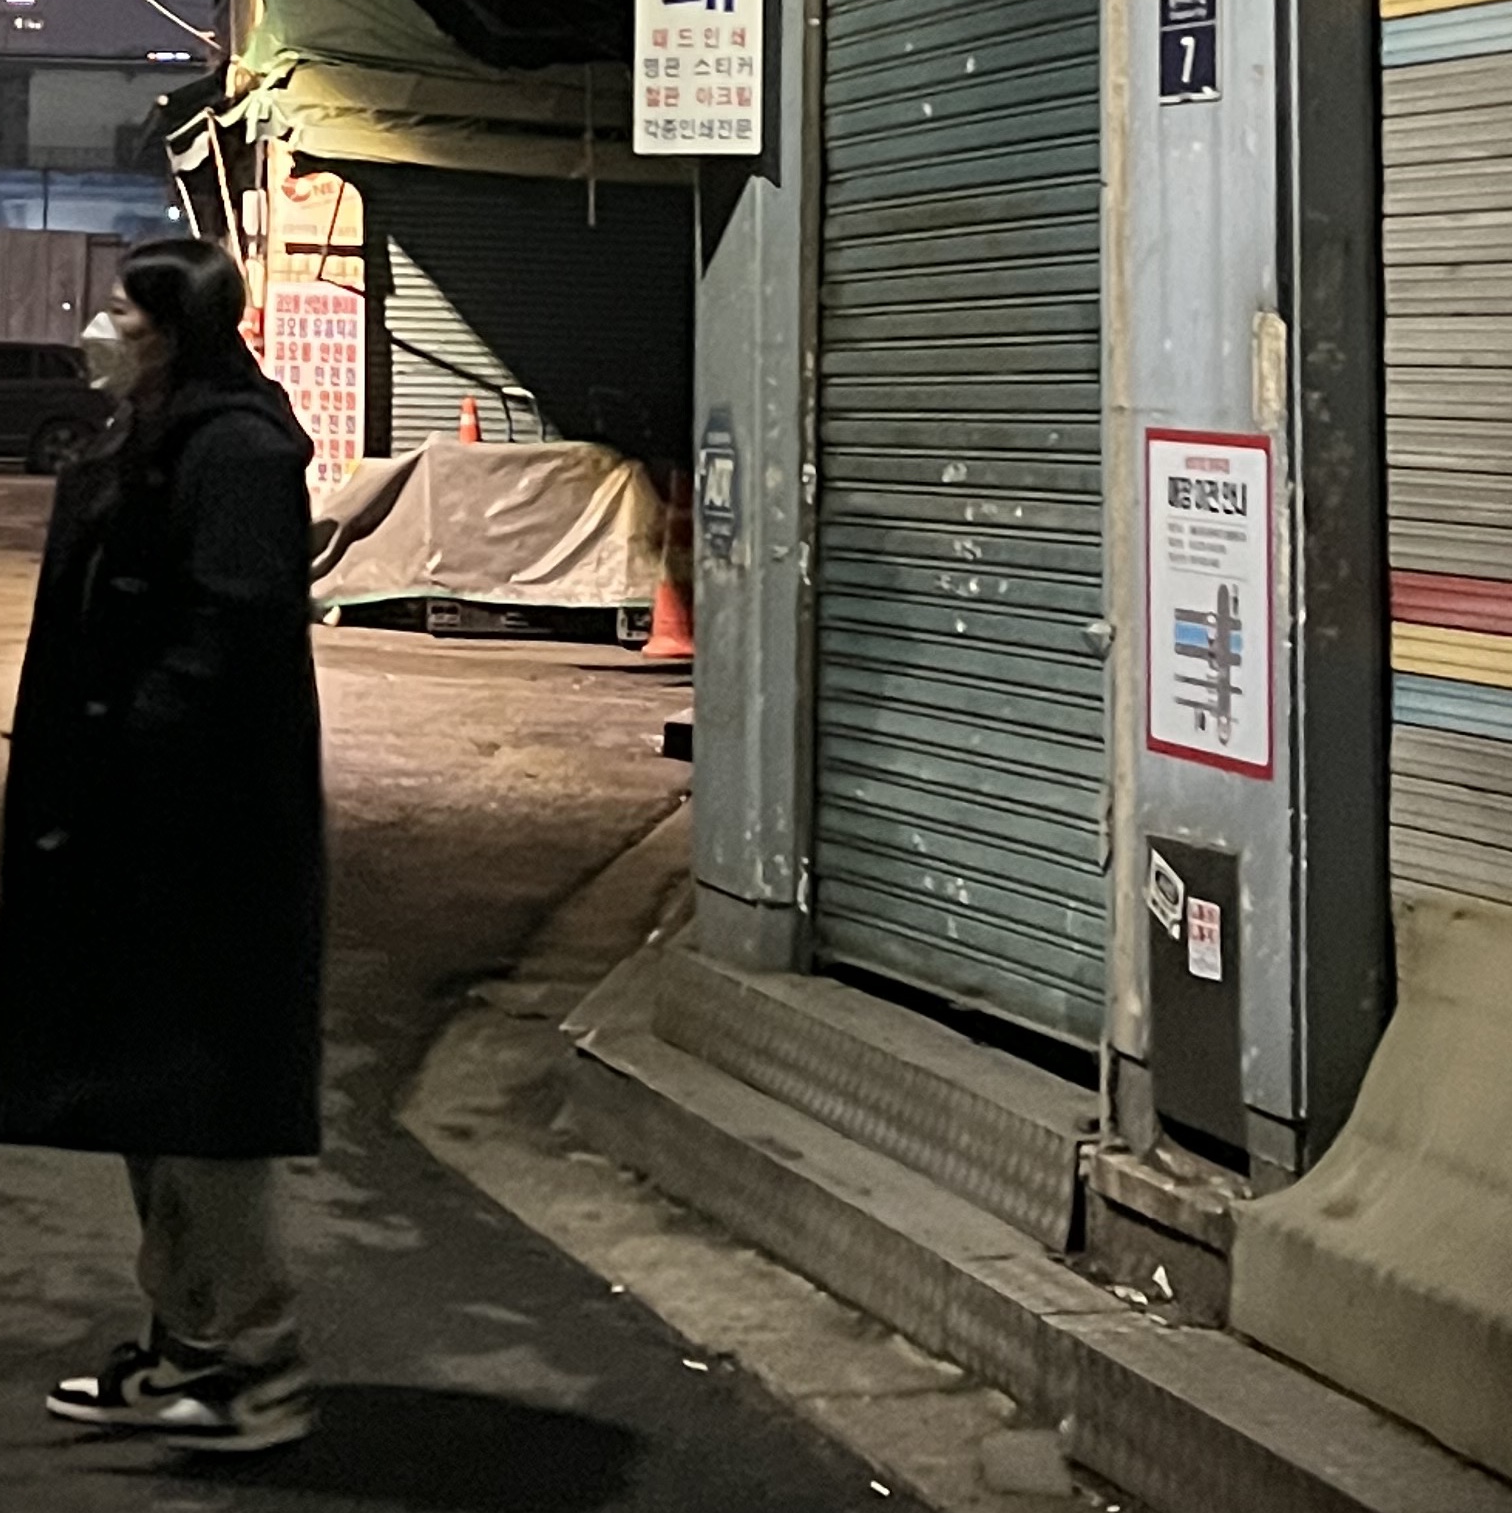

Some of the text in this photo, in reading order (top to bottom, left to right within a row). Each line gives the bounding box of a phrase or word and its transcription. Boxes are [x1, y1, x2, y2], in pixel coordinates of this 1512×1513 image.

[694, 56, 754, 77] 스티커
[694, 86, 753, 108] 아크릴
[643, 118, 753, 140] 각종인쇄전문
